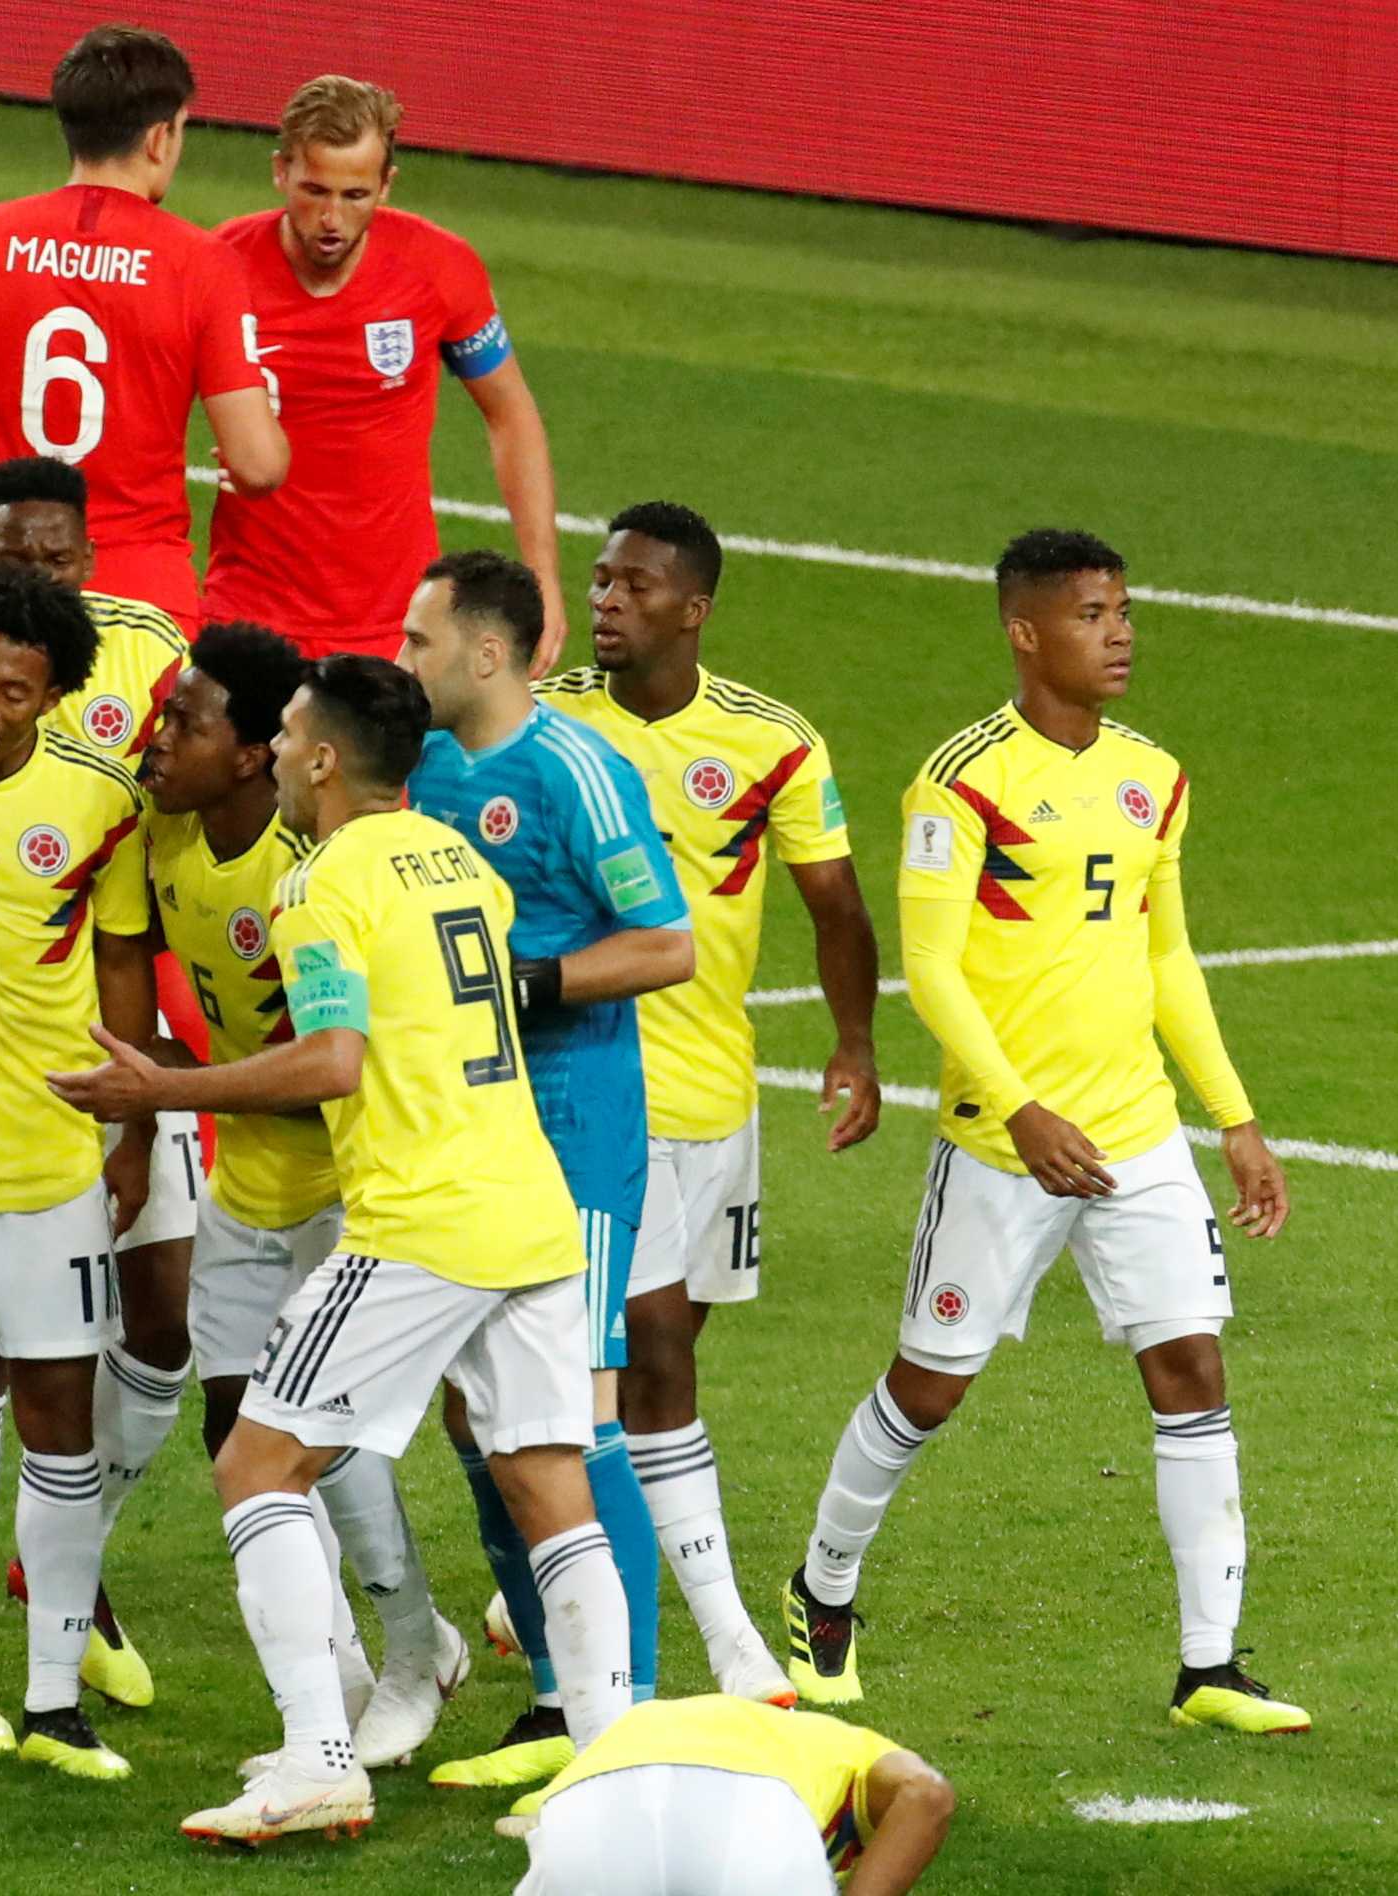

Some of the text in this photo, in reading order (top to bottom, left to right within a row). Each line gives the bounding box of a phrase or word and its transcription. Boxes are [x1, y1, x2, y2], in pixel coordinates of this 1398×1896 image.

[6, 235, 152, 286] MAGUIRE
[21, 305, 109, 466] 6
[390, 845, 480, 890] FALCAO
[1085, 854, 1114, 921] 5
[190, 960, 225, 1030] 6
[432, 905, 518, 1088] 9
[171, 1131, 204, 1201] 1
[69, 1253, 111, 1323] 11
[680, 1534, 717, 1559] FCF
